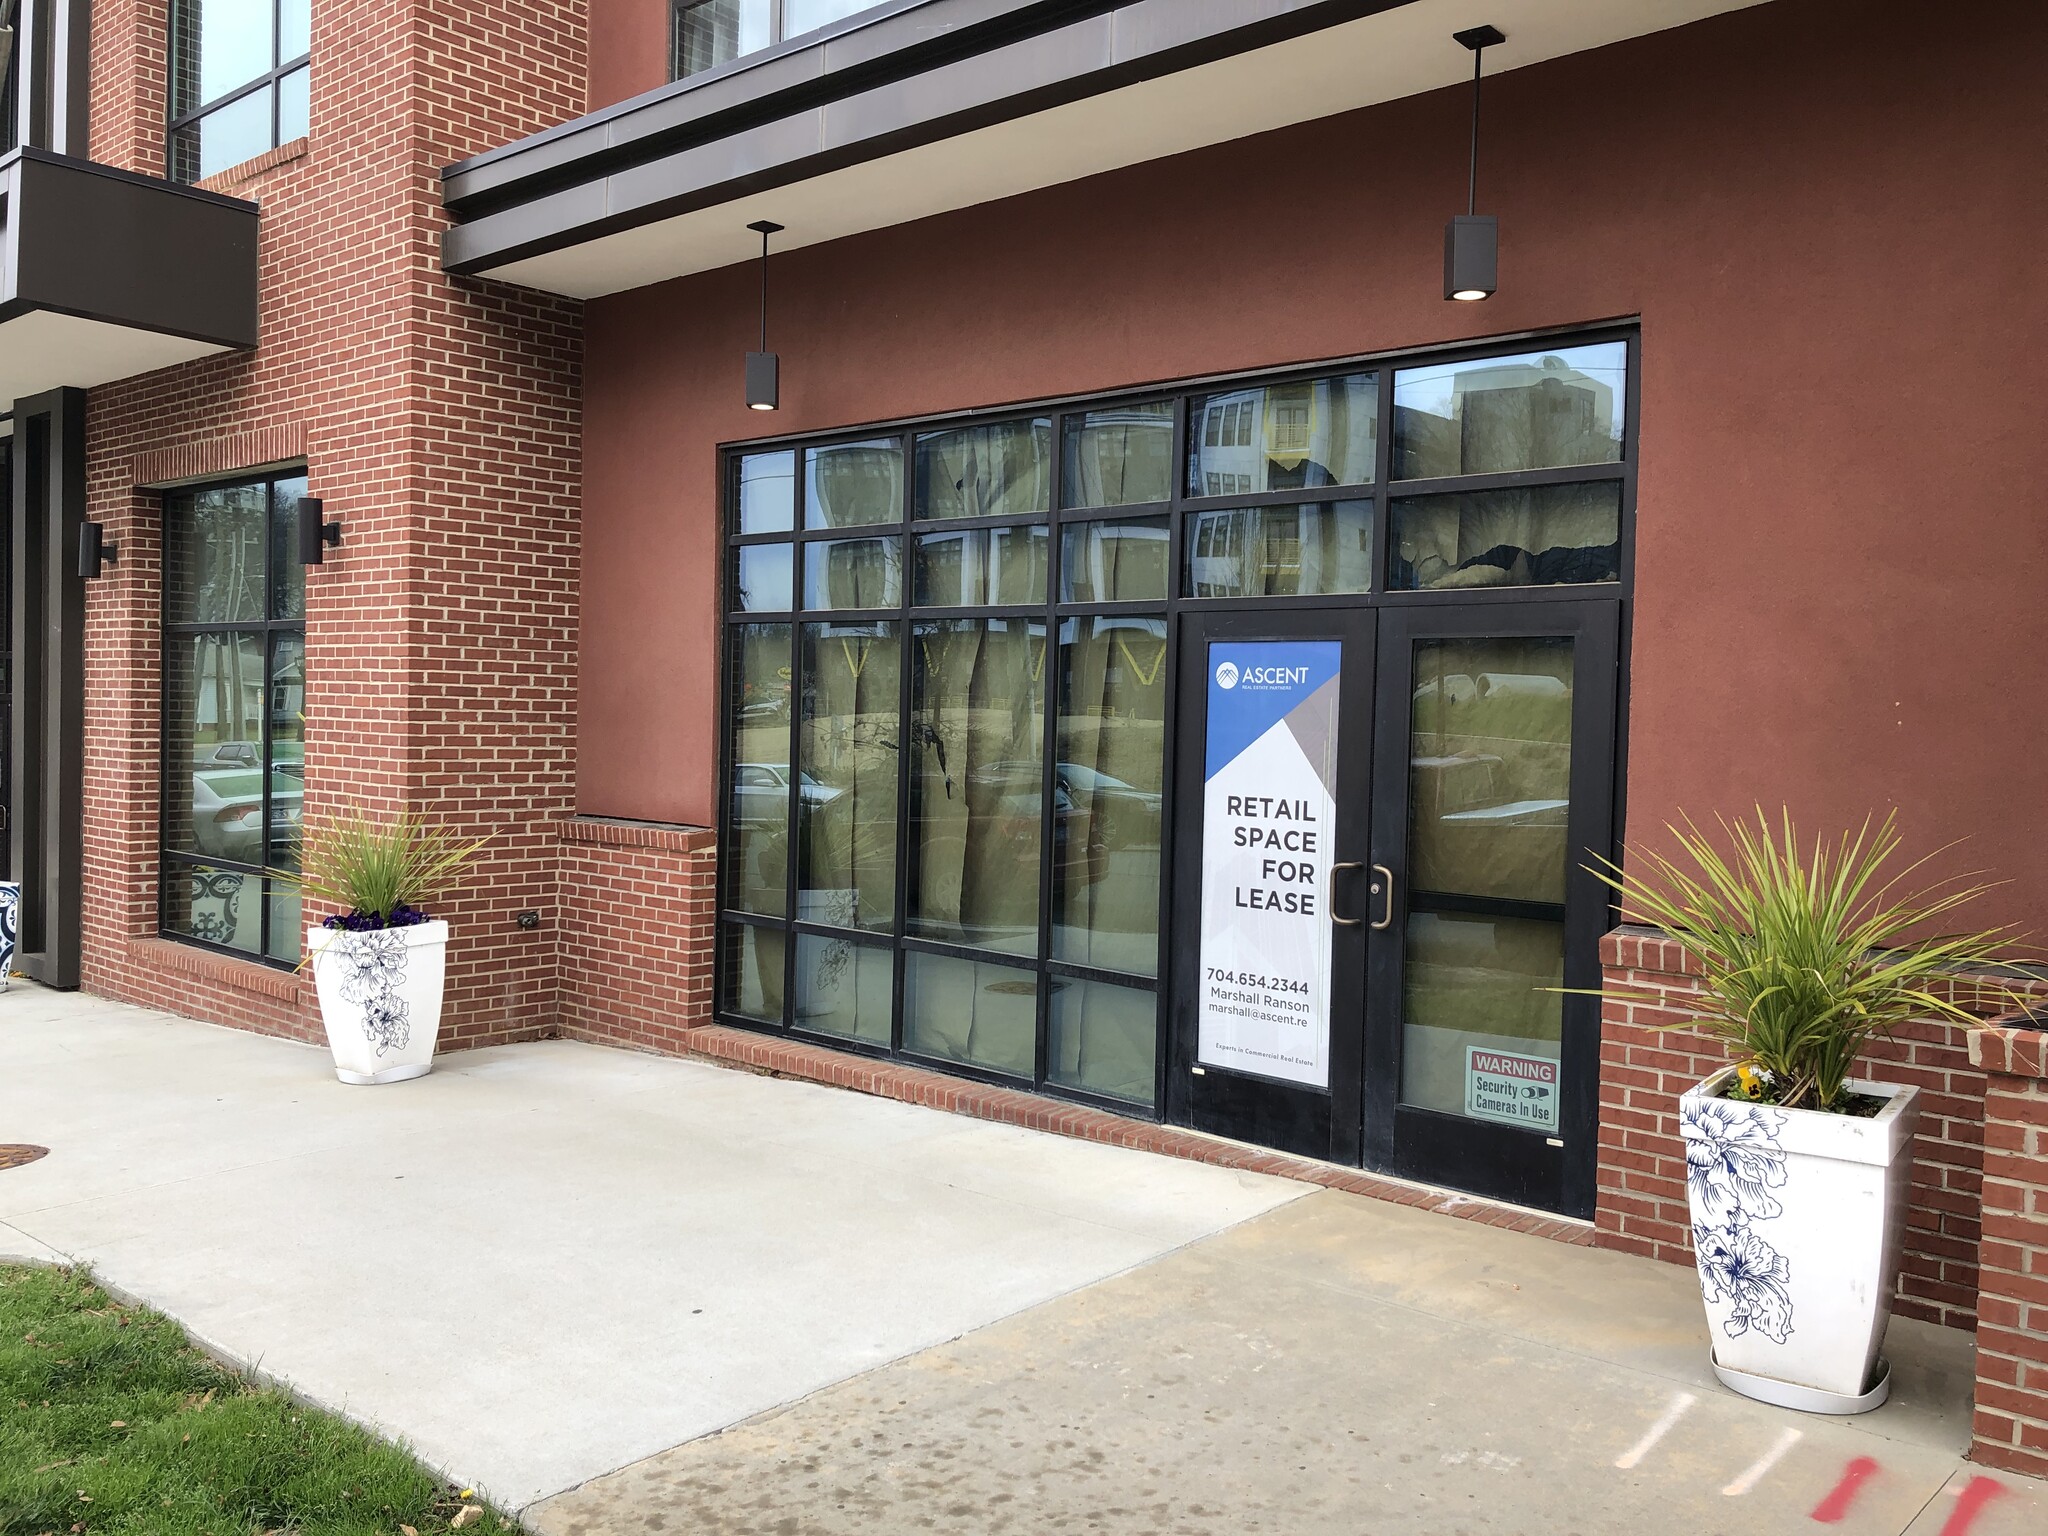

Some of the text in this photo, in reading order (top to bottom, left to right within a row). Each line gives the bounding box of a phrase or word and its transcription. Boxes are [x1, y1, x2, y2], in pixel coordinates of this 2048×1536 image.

[1242, 666, 1309, 684] ASCENT
[1227, 795, 1316, 822] RETAIL
[1233, 826, 1317, 853] SPACE
[1262, 859, 1315, 884] FOR
[1235, 886, 1315, 915] LEASE
[1207, 967, 1309, 995] 704.654.2344
[1210, 986, 1310, 1013] Marshall Ranson
[1208, 1003, 1308, 1027] marshall@ascent.re
[1215, 1042, 1237, 1052] Experts
[1245, 1048, 1279, 1060] Commercial
[1280, 1055, 1294, 1063] Real
[1295, 1058, 1314, 1067] Estate
[1475, 1055, 1552, 1080] WARNING
[1476, 1076, 1518, 1099] Security
[1476, 1094, 1517, 1115] Cameras
[1520, 1101, 1529, 1116] In
[1532, 1103, 1550, 1120] Use
